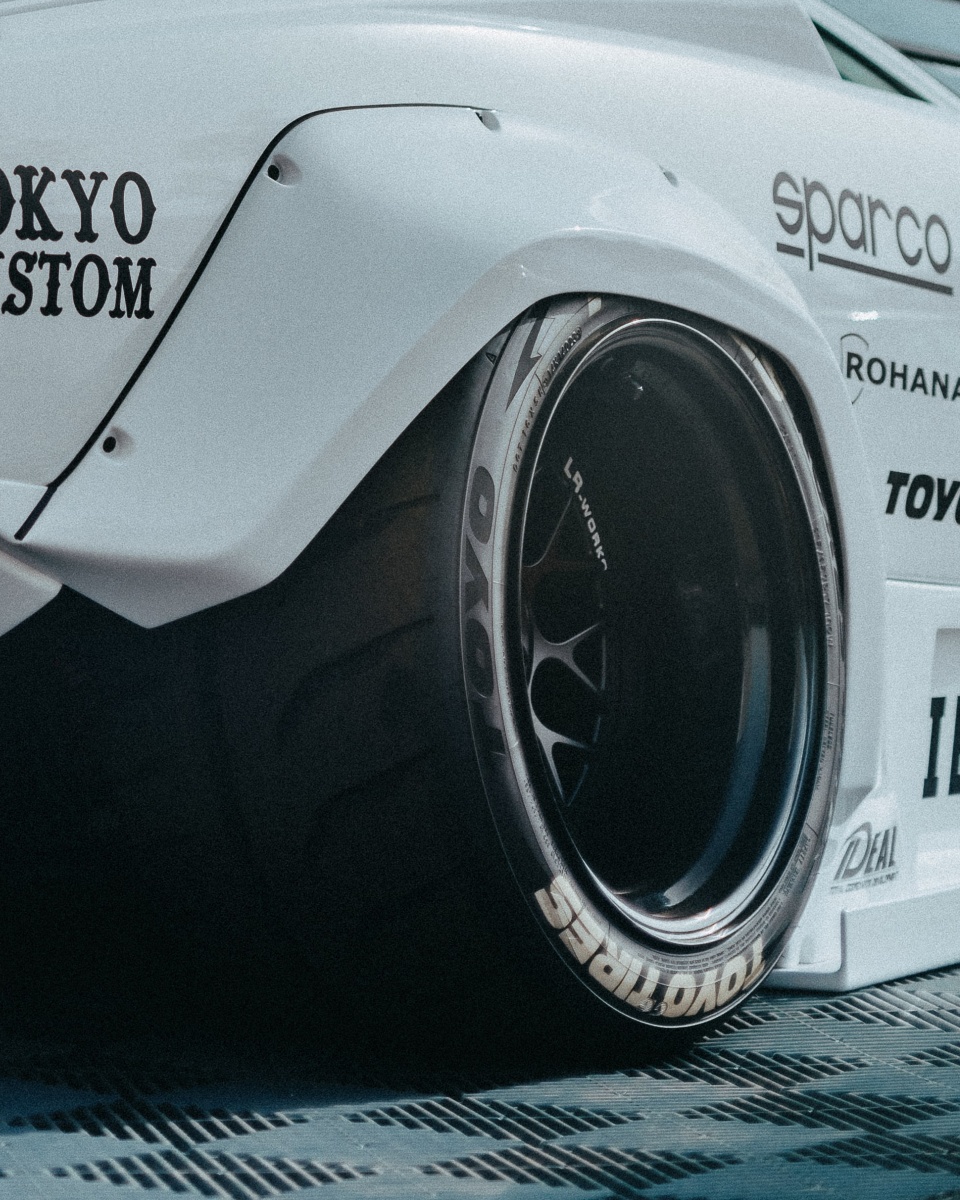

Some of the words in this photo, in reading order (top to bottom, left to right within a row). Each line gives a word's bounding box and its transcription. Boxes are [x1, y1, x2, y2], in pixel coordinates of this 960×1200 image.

[773, 172, 951, 274] sparco
[885, 470, 960, 525] TOY
[833, 822, 897, 881] IDEAL
[534, 875, 661, 1013] TIRES
[661, 937, 766, 1018] TOYO
